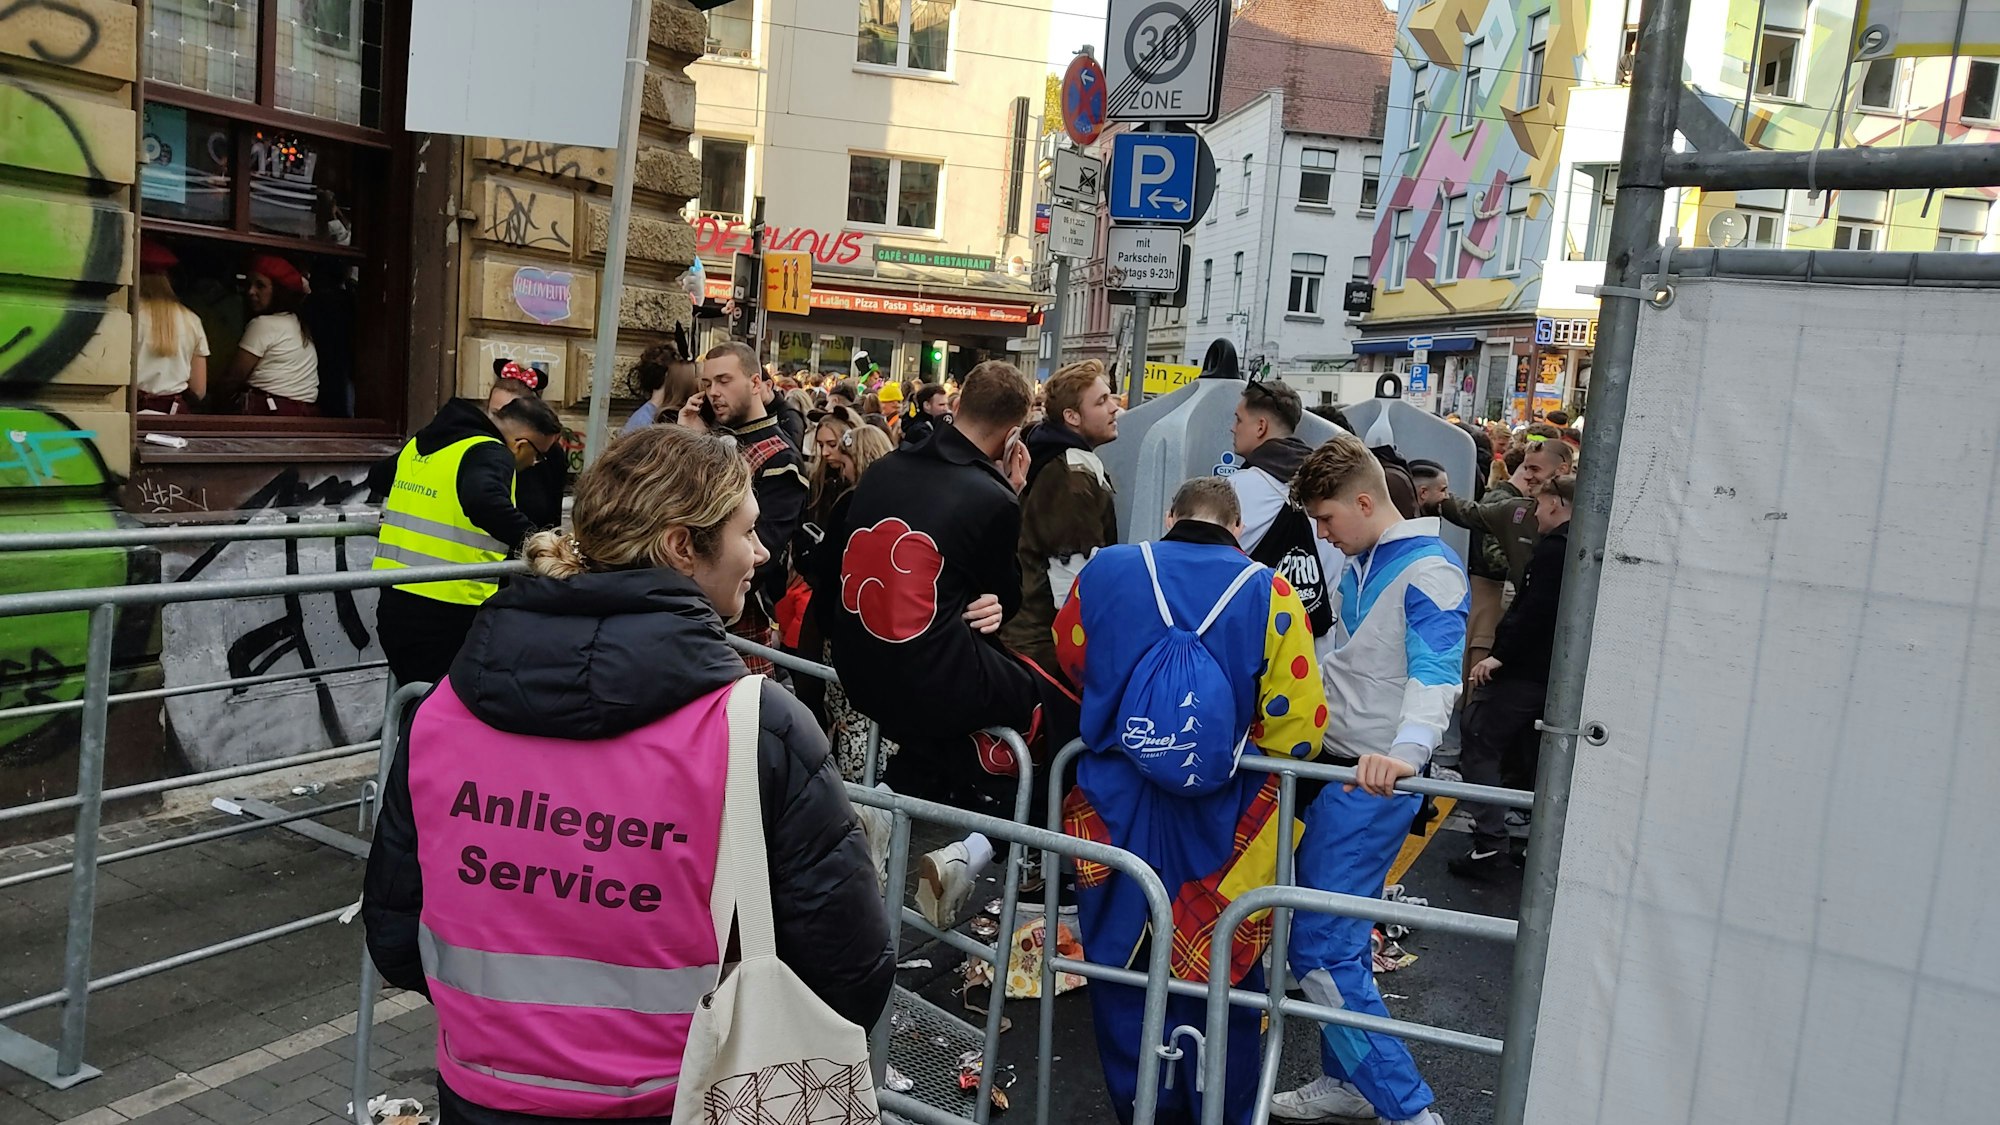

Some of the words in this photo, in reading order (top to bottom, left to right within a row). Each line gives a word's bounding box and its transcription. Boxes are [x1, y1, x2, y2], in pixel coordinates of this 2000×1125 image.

[1128, 90, 1183, 109] ZONE
[1130, 145, 1176, 208] P
[1136, 237, 1151, 248] mit
[878, 249, 902, 261] CAFÉ
[908, 253, 926, 264] BAR
[933, 255, 991, 270] RESTAURANT
[1117, 251, 1168, 264] Parkschein
[1149, 267, 1175, 279] 9-23h
[854, 297, 879, 310] Pizza
[883, 300, 908, 313] Pasta
[912, 303, 935, 314] Salat
[942, 304, 977, 317] Cocktail
[449, 780, 688, 852] Anlieger-
[457, 845, 662, 913] Service
